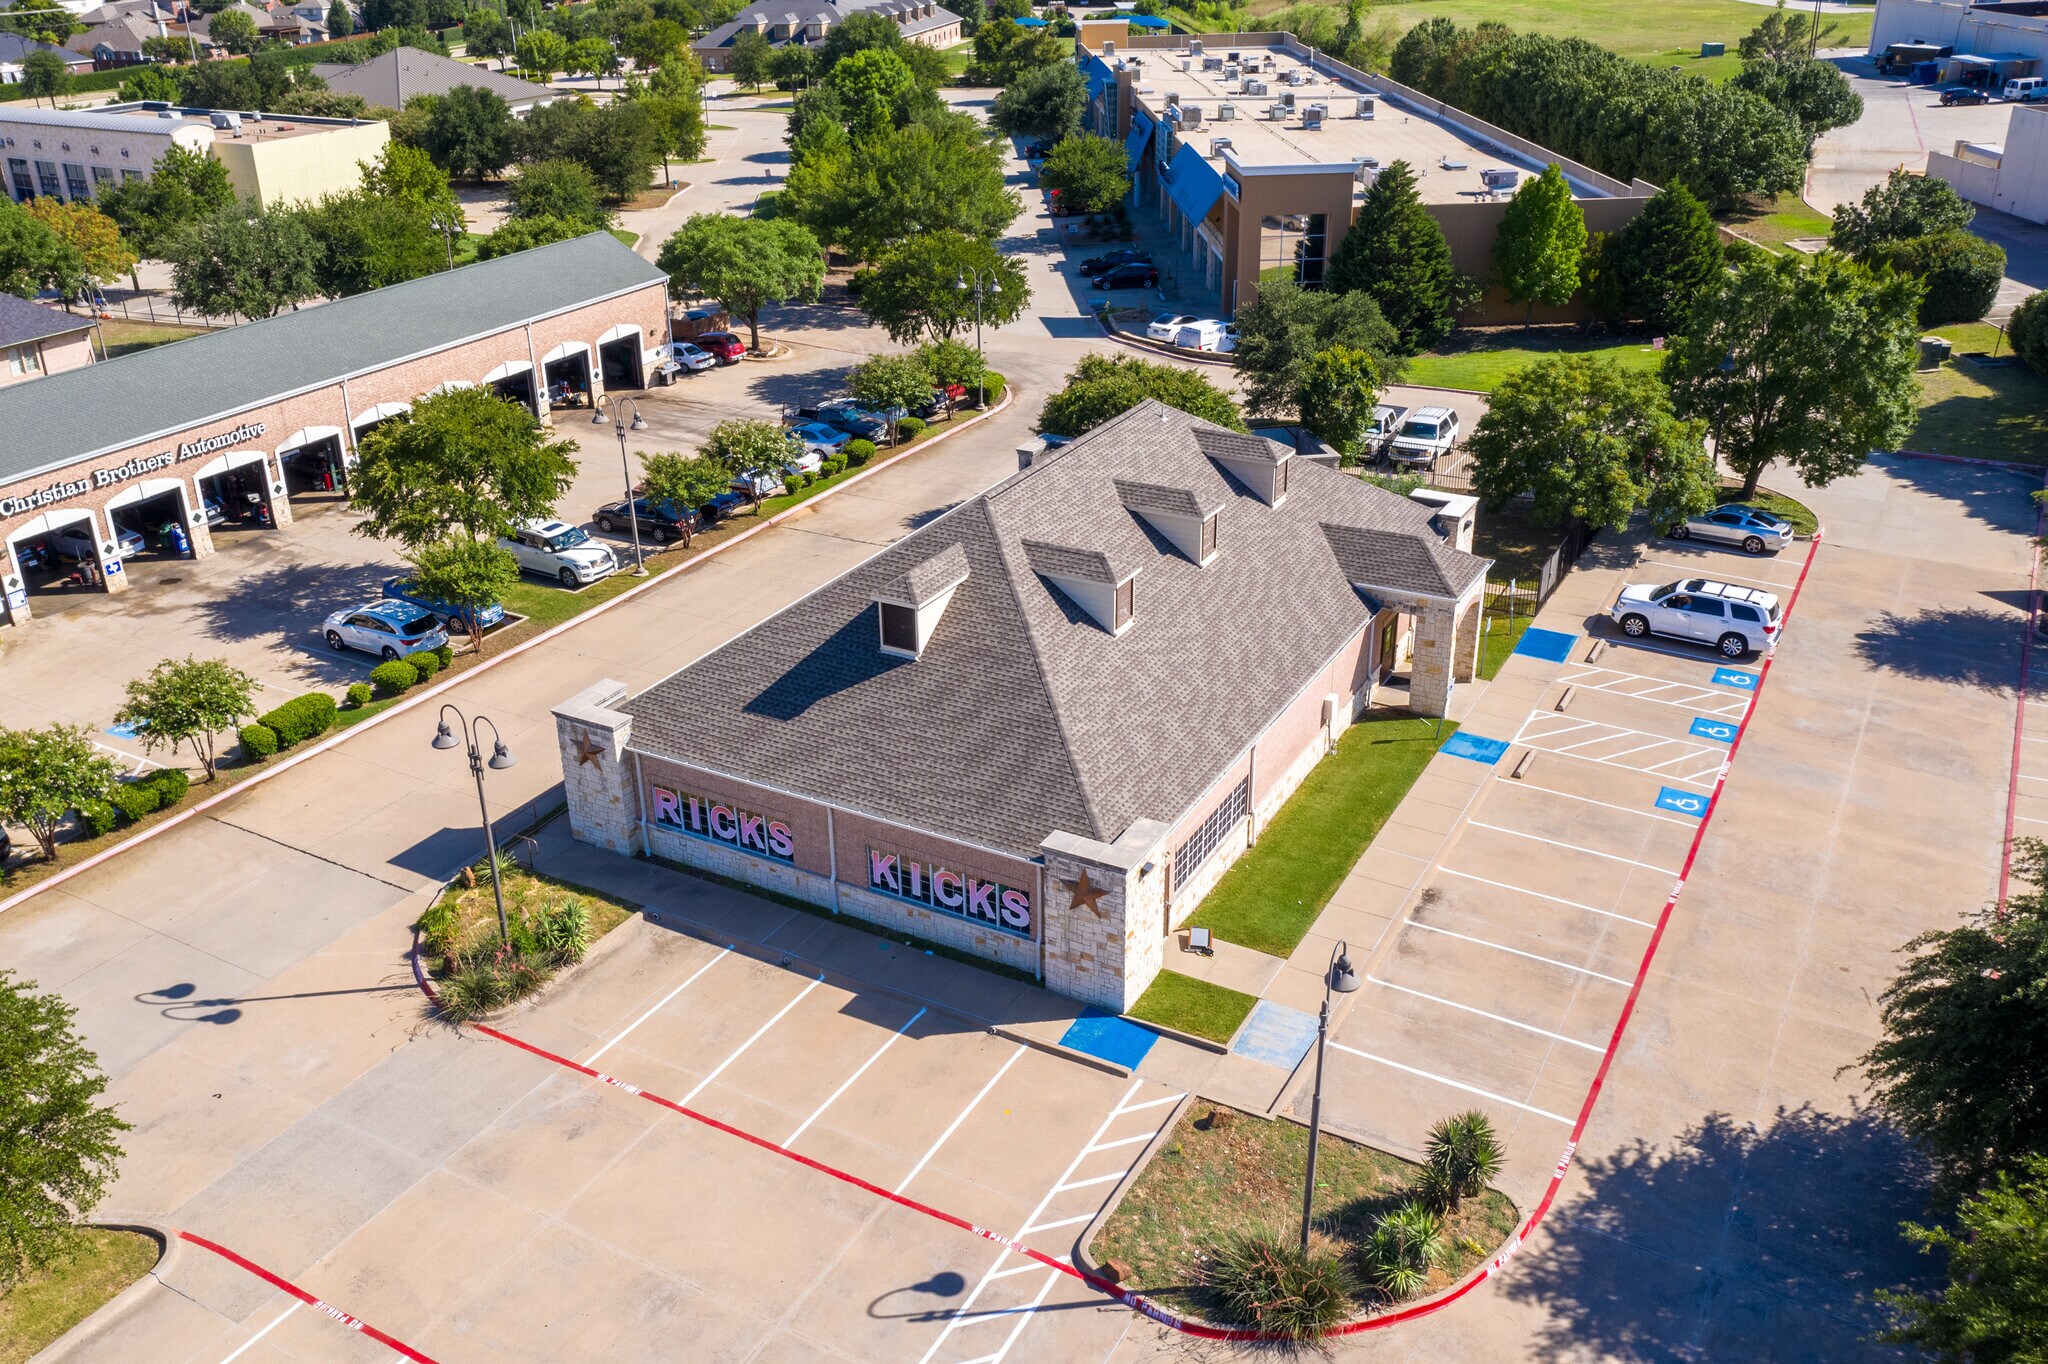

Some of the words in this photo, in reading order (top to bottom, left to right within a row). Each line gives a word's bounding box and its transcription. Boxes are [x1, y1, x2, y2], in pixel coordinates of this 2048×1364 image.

[0, 479, 91, 516] Christian
[94, 453, 174, 487] Brothers
[179, 422, 267, 460] Automotive
[653, 787, 795, 857] RICKS
[871, 850, 1030, 928] KICKS
[971, 1225, 986, 1236] NO
[989, 1233, 1028, 1253] PARKG
